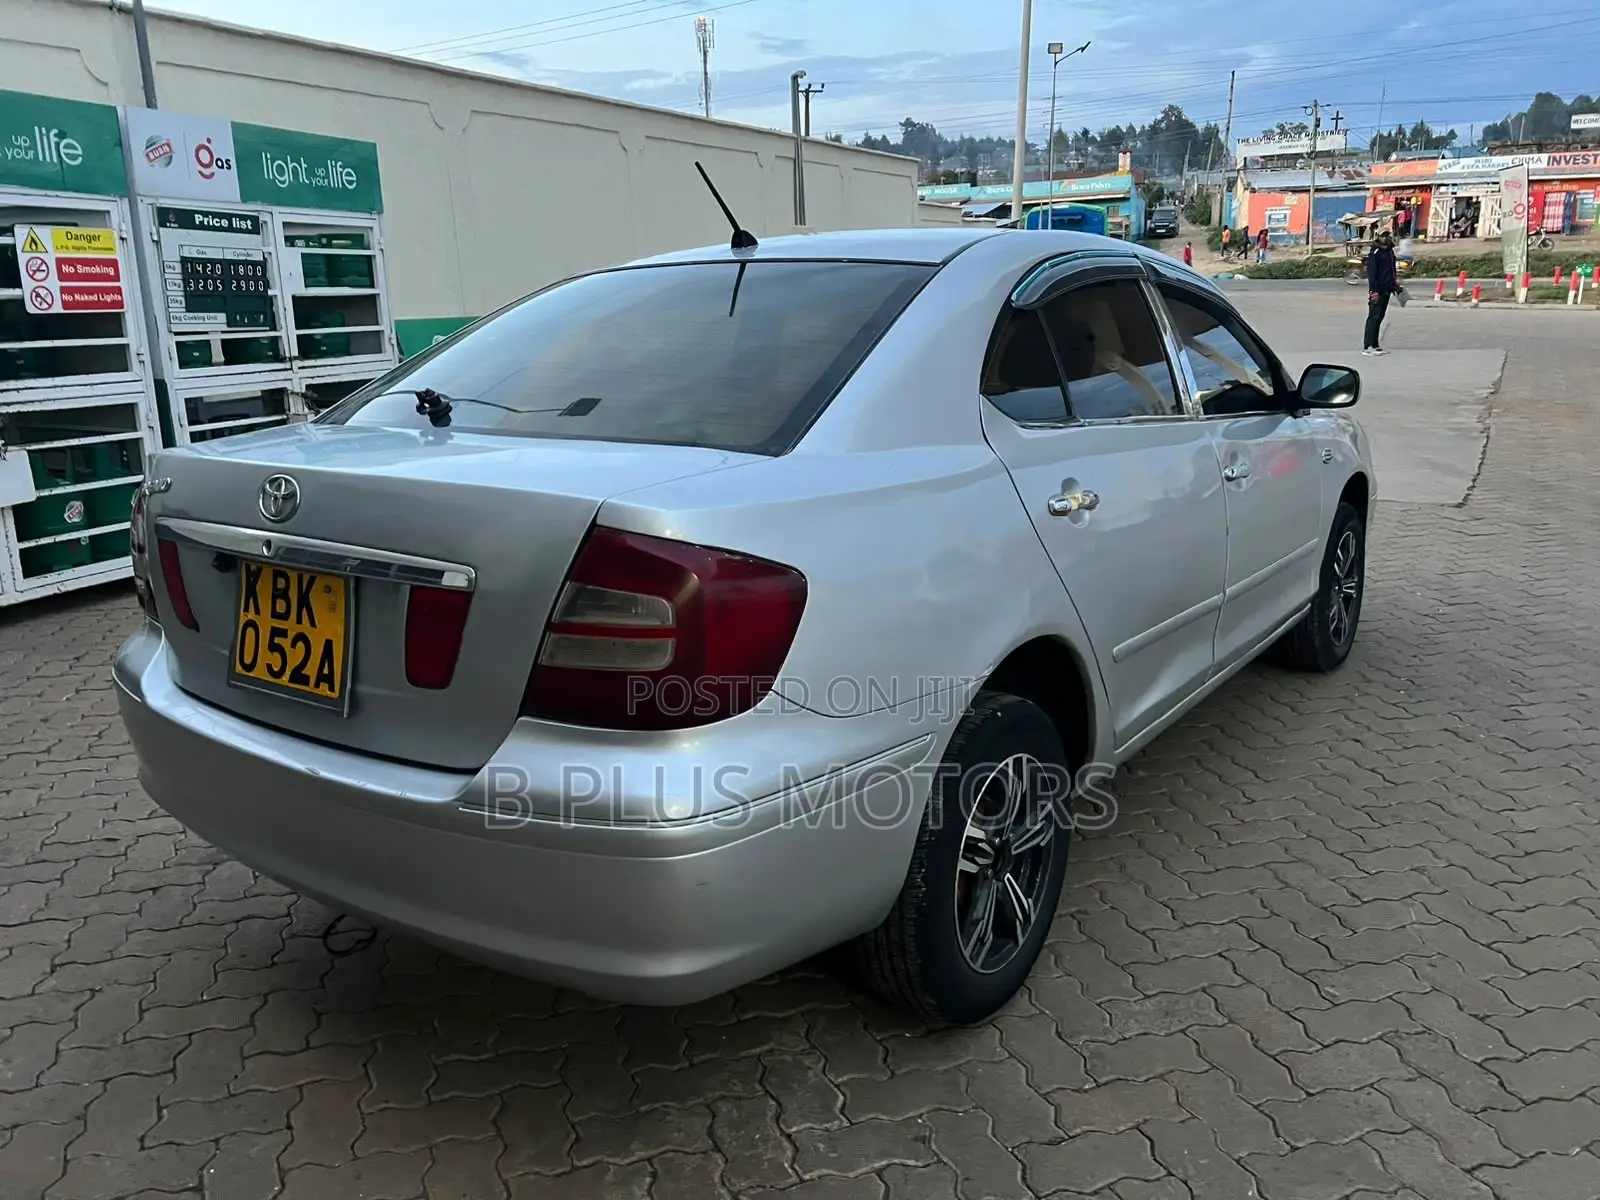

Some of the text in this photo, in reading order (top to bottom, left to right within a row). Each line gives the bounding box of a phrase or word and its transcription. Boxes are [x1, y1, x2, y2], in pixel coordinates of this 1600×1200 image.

[4, 126, 83, 166] up your life
[1252, 134, 1276, 143] LIVING
[194, 137, 232, 180] gas
[261, 151, 357, 190] light up your life
[194, 213, 229, 227] Price
[231, 217, 253, 230] list
[65, 231, 102, 244] Danger
[61, 264, 115, 276] No Smoking
[187, 262, 263, 277] 1420 1800
[231, 280, 264, 291] 2900
[62, 293, 122, 303] No Naked Lights
[183, 313, 206, 322] Cooking
[242, 560, 317, 629] KBK
[238, 619, 336, 694] 052A
